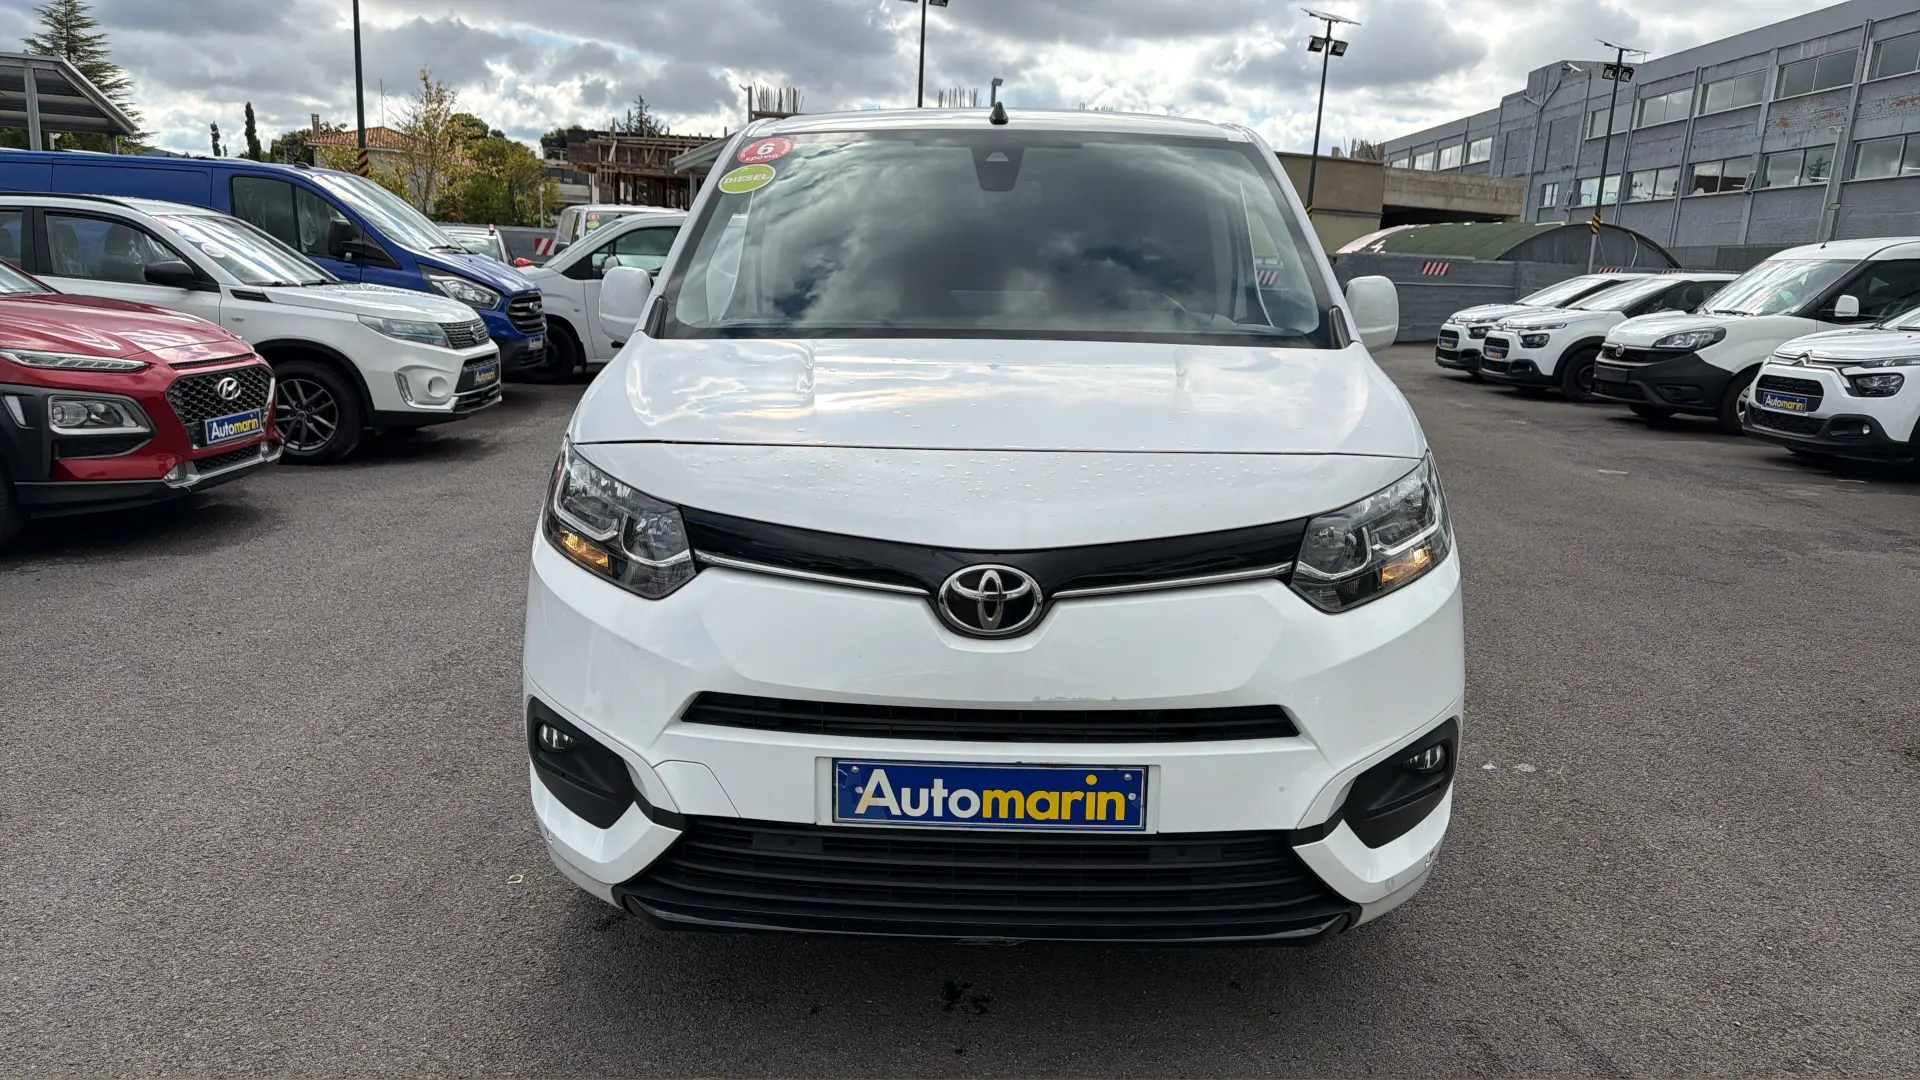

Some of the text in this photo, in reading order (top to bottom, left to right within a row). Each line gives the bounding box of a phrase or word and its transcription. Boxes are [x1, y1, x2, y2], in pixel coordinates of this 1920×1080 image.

[757, 142, 775, 155] 6
[724, 173, 771, 185] DIESEL
[1765, 394, 1803, 411] Automarin
[211, 414, 259, 440] Automarin
[854, 768, 1126, 822] Automarin
